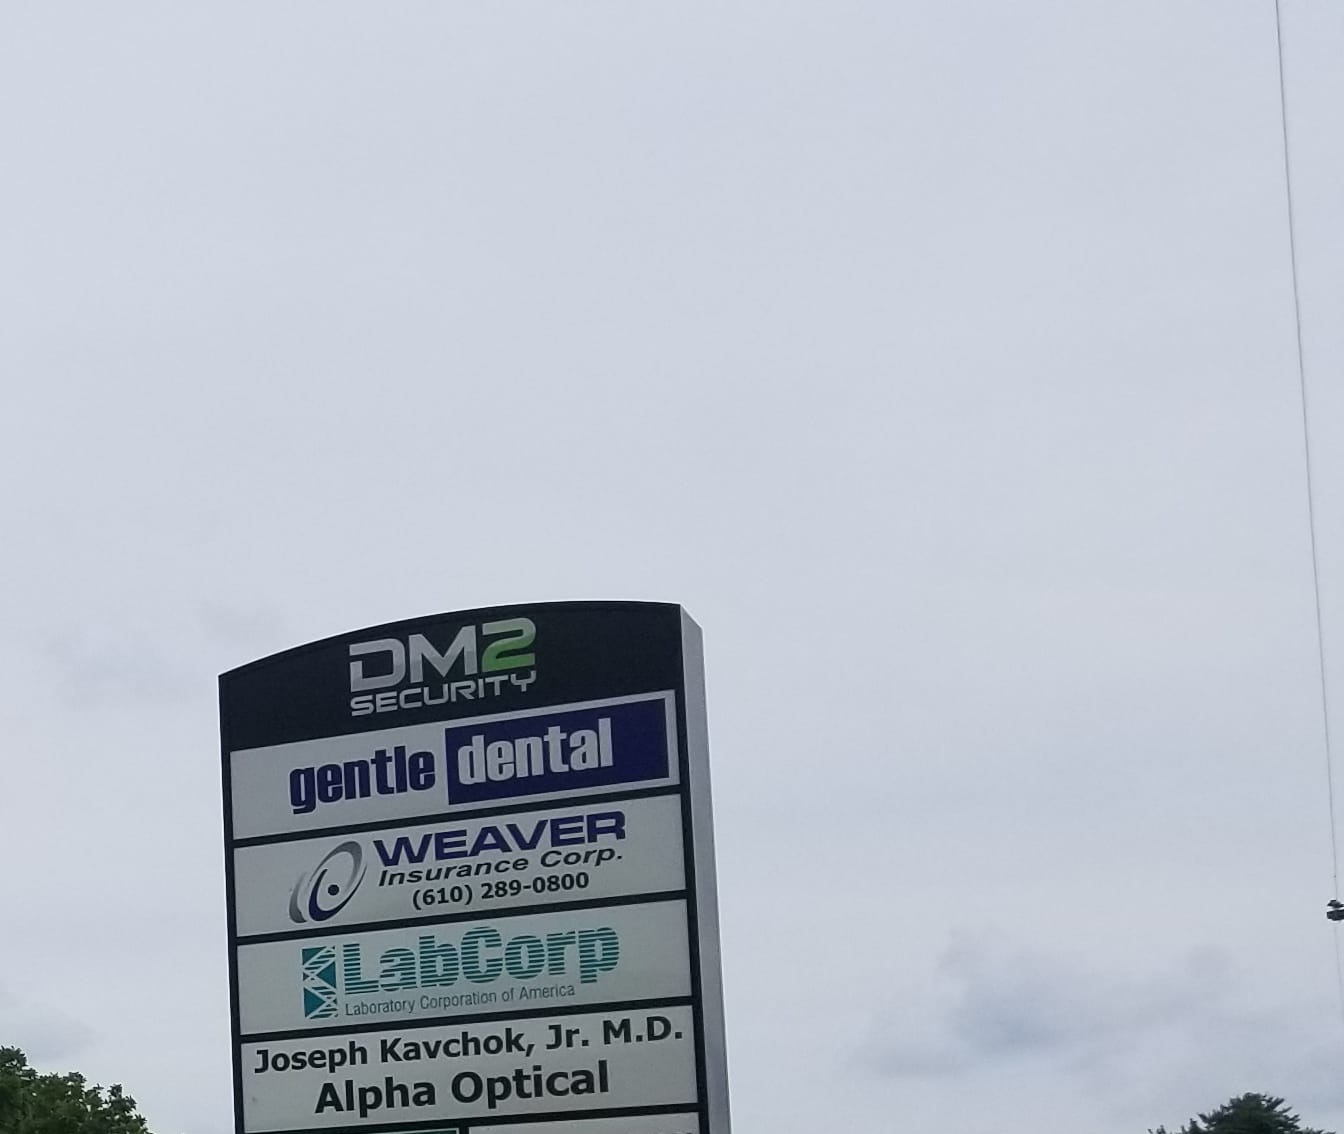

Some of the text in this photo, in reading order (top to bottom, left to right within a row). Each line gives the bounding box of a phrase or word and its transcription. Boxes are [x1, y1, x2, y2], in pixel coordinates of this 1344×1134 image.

[349, 617, 537, 693] DM2
[350, 670, 537, 717] SECURITY
[289, 718, 613, 815] gentle dental
[373, 810, 626, 866] WEAVER
[379, 847, 623, 887] Insurance Corp.
[413, 872, 589, 910] (610) 289-0800
[343, 926, 619, 995] LabCorp
[345, 983, 576, 1016] Laboratory Corporation of America
[254, 1015, 683, 1074] Joseph Kavchok, Jr. M.D.
[315, 1060, 610, 1118] Alpha Optical
